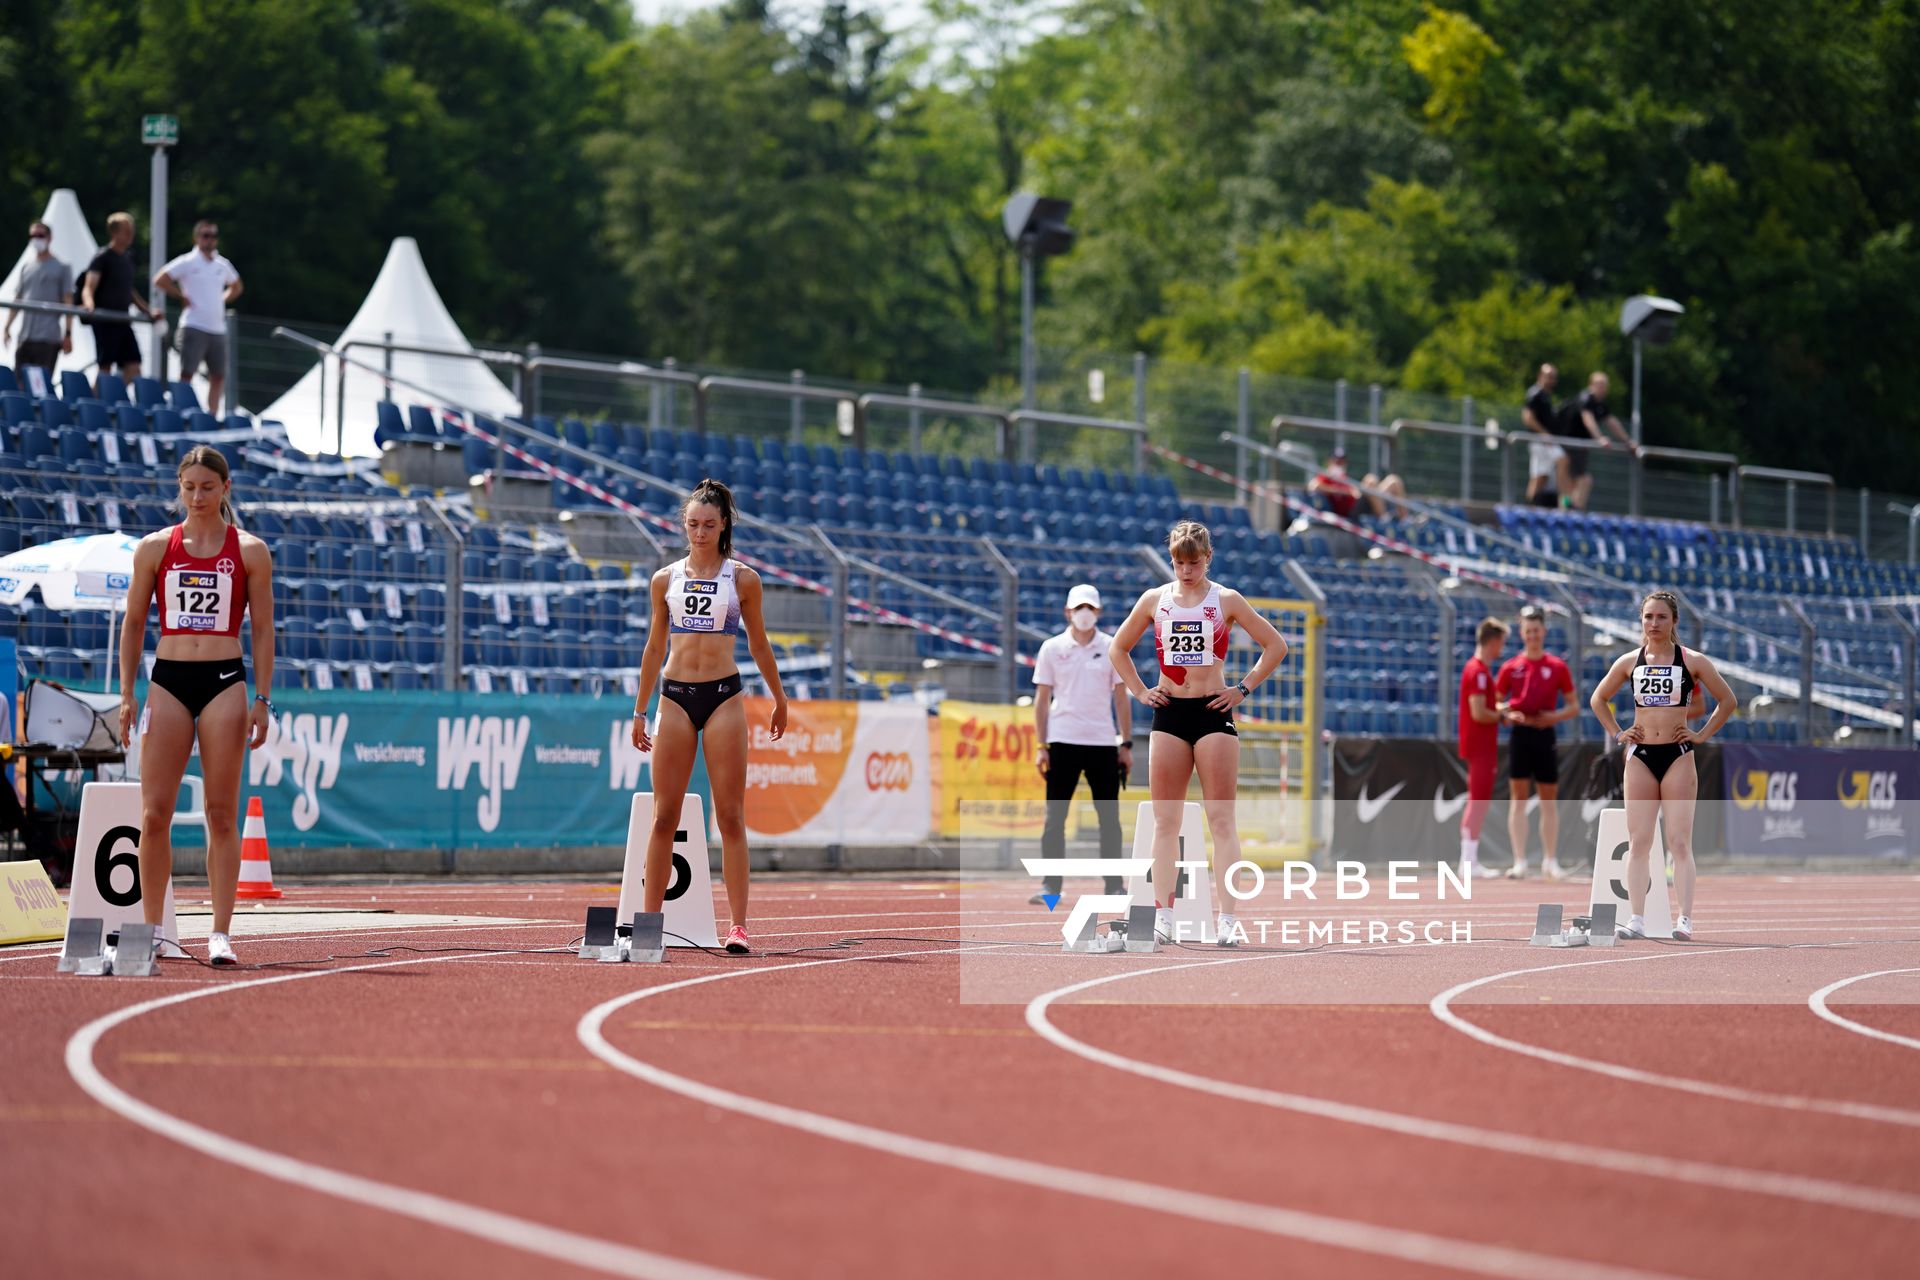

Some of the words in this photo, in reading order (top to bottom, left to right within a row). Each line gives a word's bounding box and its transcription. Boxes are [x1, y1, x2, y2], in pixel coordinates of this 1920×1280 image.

[198, 576, 215, 586] GLS
[700, 584, 715, 592] GLS
[176, 591, 221, 615] 122
[684, 595, 712, 616] 92
[192, 617, 215, 625] PLAN
[1169, 636, 1206, 652] 233
[1640, 678, 1673, 694] 259
[814, 728, 842, 753] und
[354, 743, 426, 767] Versicherung
[535, 744, 600, 767] Versicherung
[1766, 771, 1798, 811] GLS
[1869, 771, 1898, 810] GLS
[95, 826, 142, 906] 6
